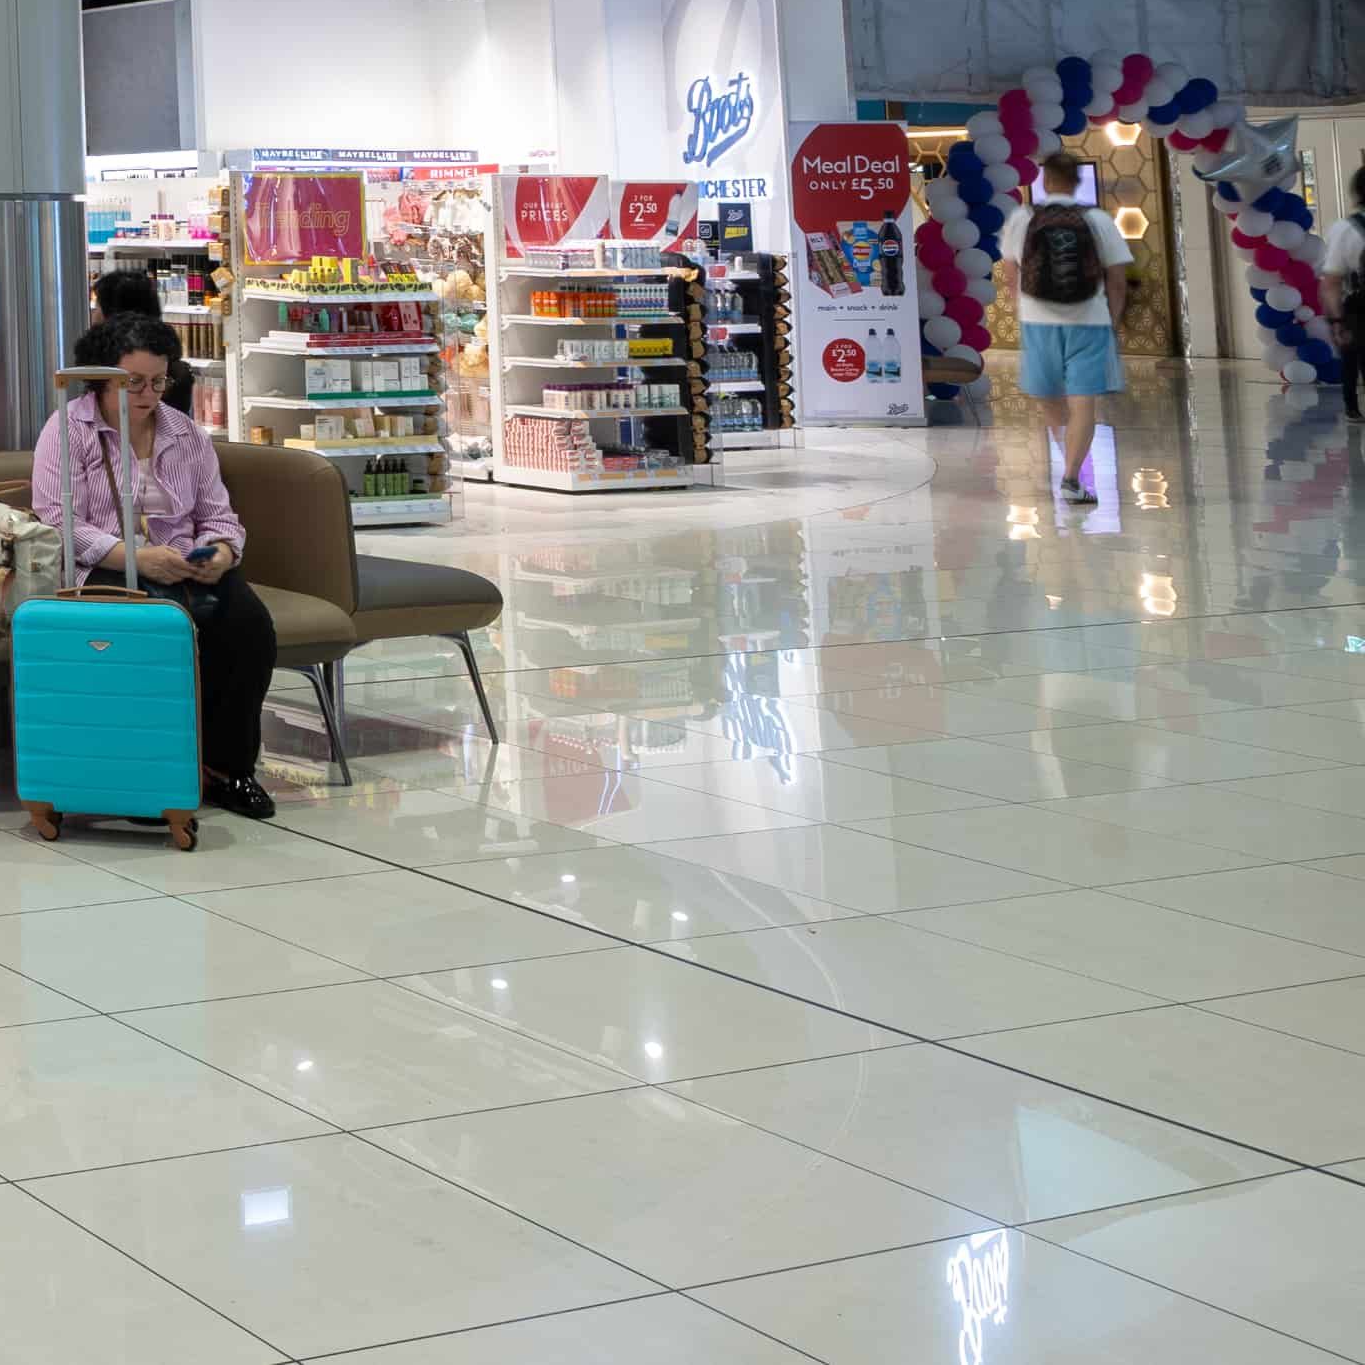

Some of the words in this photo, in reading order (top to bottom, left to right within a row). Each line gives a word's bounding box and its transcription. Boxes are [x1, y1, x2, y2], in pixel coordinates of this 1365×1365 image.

[683, 72, 754, 167] Boots
[261, 150, 322, 159] MAYBELLINE
[338, 150, 398, 160] MAYBELLINE
[413, 151, 471, 160] MAYBELLINE
[802, 155, 851, 174] Meal
[855, 155, 901, 174] Deal
[809, 180, 847, 191] ONLY
[851, 178, 894, 200] £5.50
[521, 210, 569, 222] PRICES
